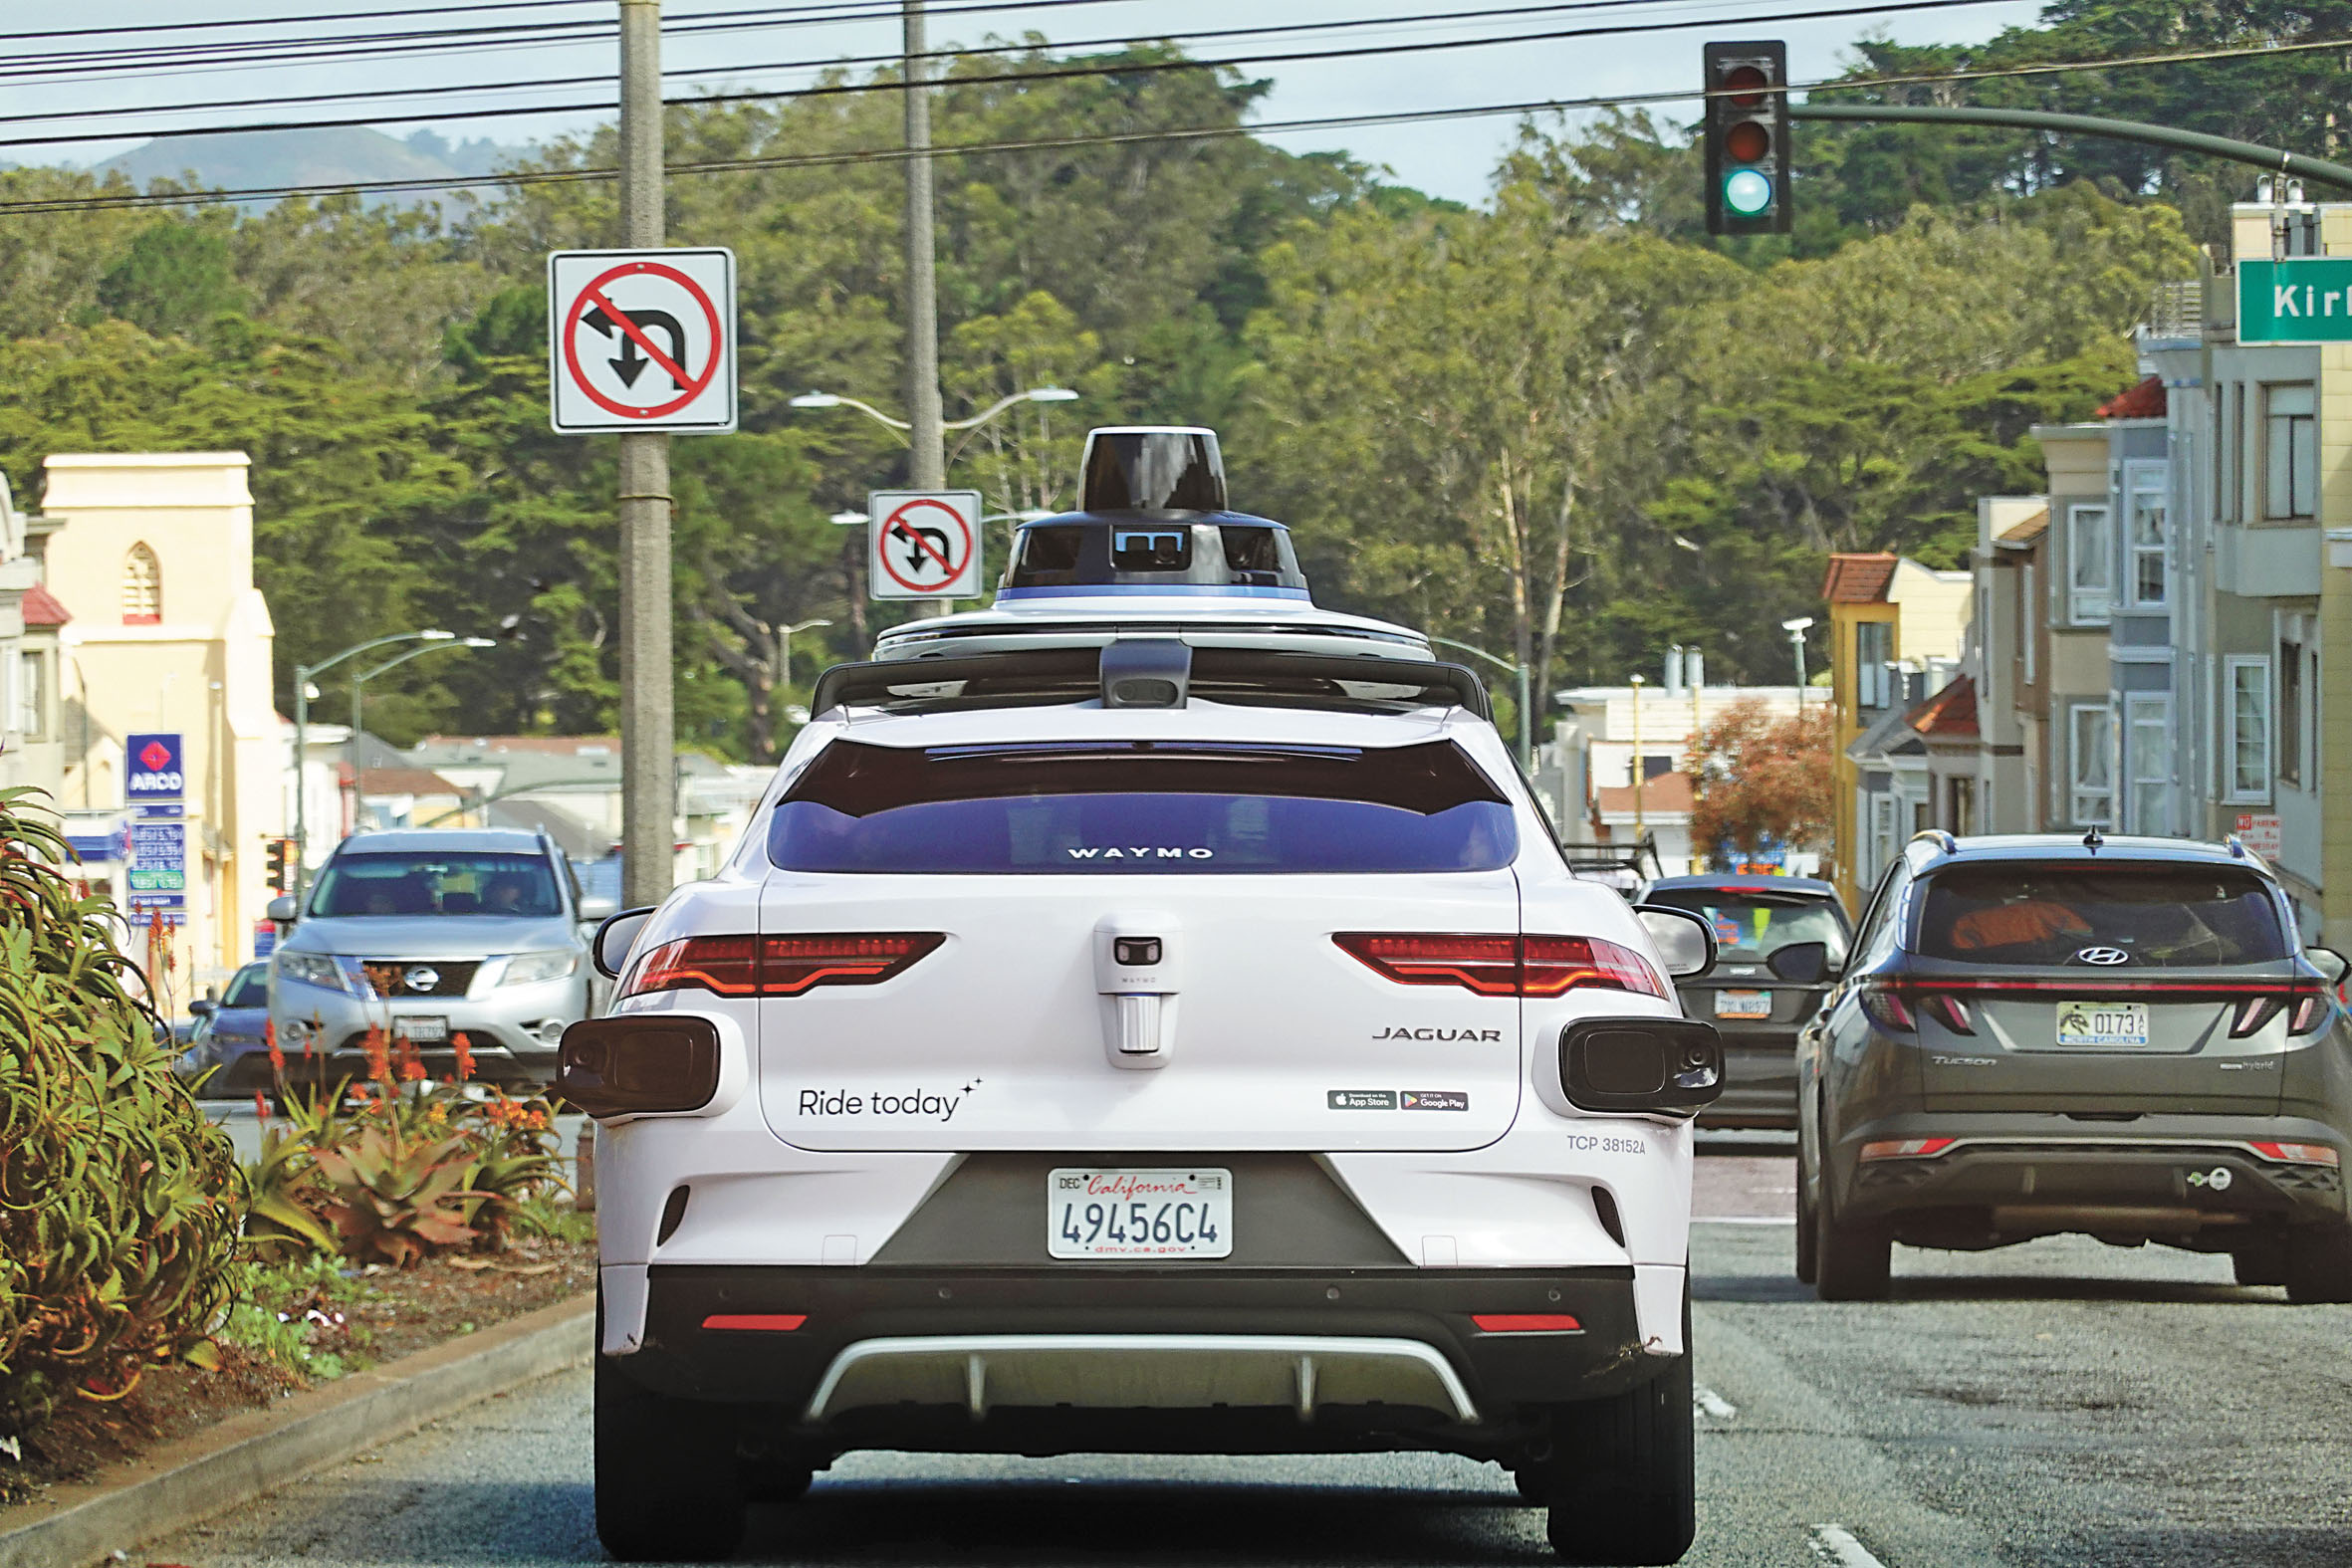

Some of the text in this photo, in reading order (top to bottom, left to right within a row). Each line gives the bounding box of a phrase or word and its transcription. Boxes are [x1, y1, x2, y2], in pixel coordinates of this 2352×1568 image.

[129, 772, 182, 790] ARCO
[1067, 847, 1213, 859] WAYMO
[2095, 1013, 2134, 1034] 0173
[1372, 1027, 1502, 1042] JAGUAR
[799, 1088, 960, 1123] Ride today
[1348, 1098, 1366, 1107] App
[1420, 1099, 1465, 1109] Google Play
[1567, 1135, 1646, 1156] TCP 38152A
[1059, 1178, 1081, 1190] DEC
[1087, 1175, 1198, 1202] California
[1061, 1203, 1218, 1243] 49456C4
[1094, 1245, 1187, 1254] dmv.ca.gov
